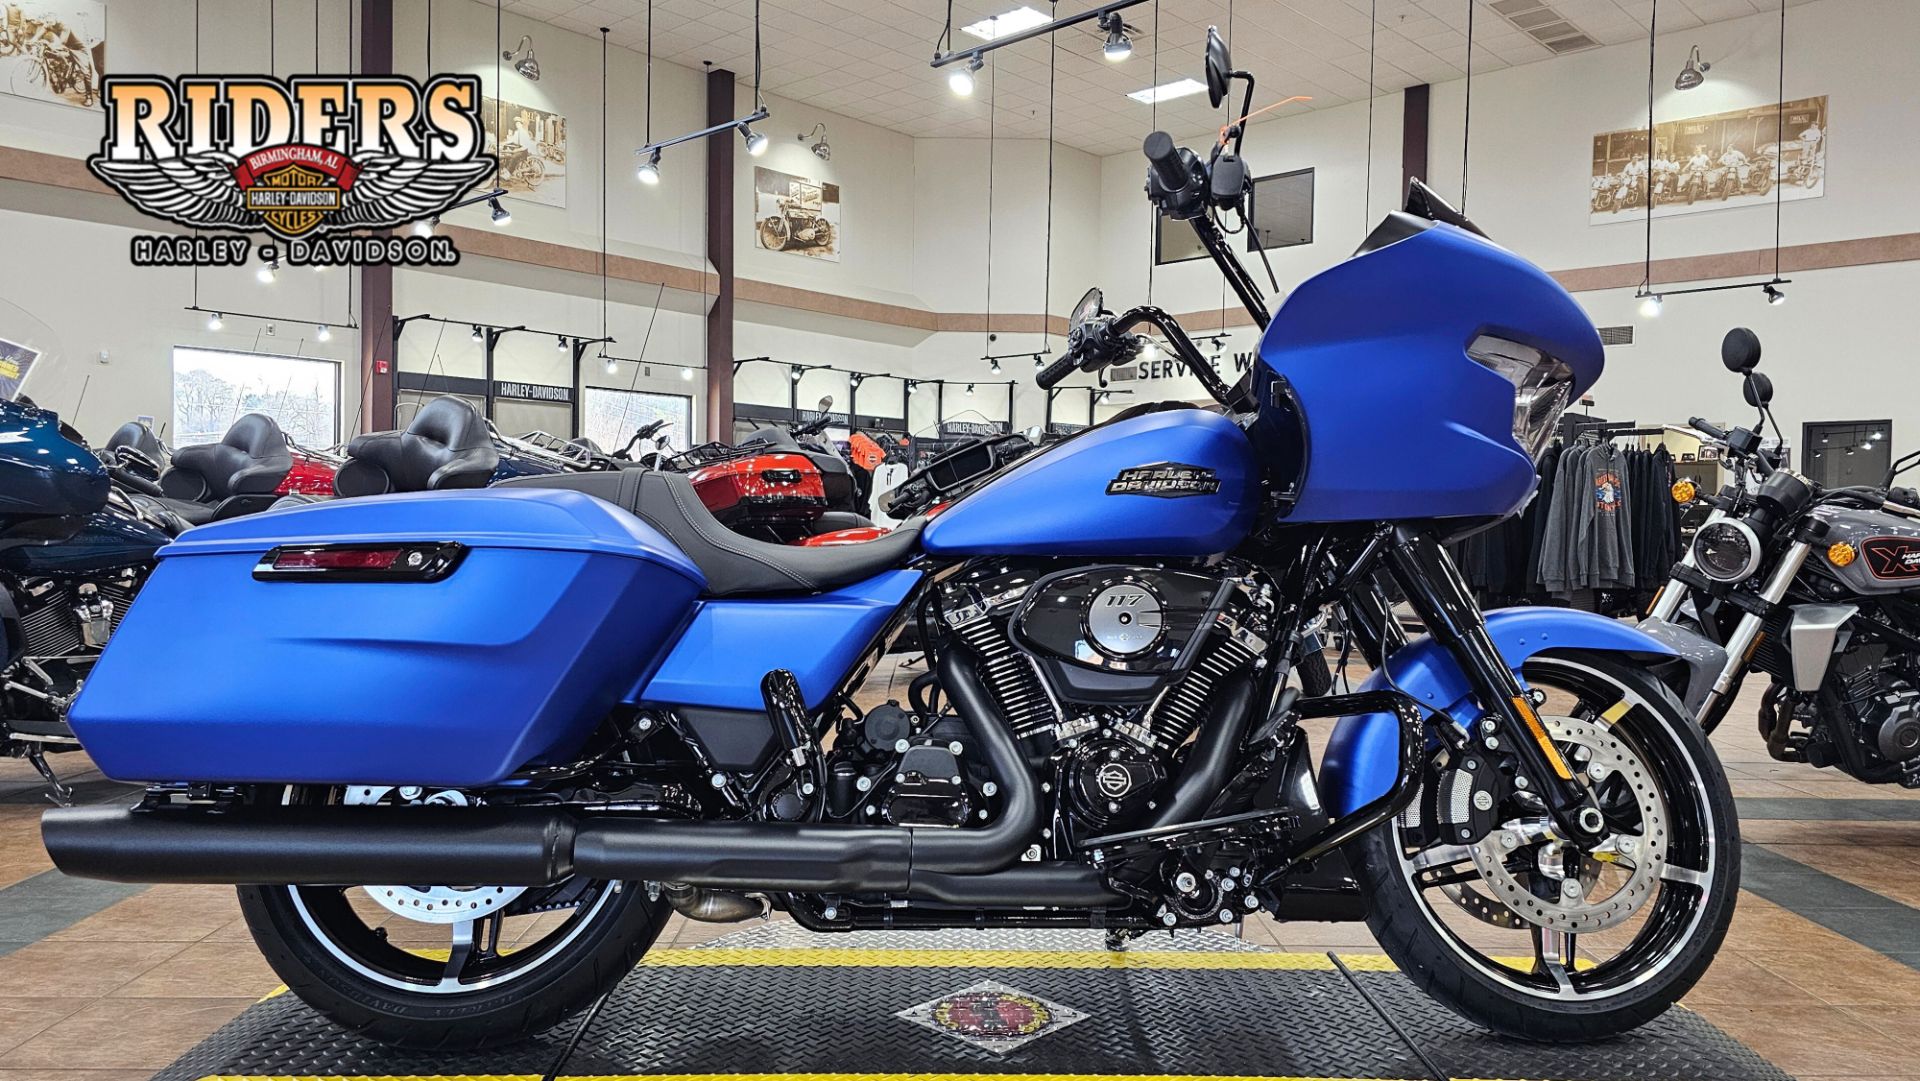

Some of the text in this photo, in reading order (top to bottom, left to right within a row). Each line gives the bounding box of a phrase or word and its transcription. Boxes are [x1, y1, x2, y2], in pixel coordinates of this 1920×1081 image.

[1138, 354, 1221, 380] SERVE
[501, 382, 569, 401] HARLEY-DAVIDSON
[1106, 594, 1145, 608] 117
